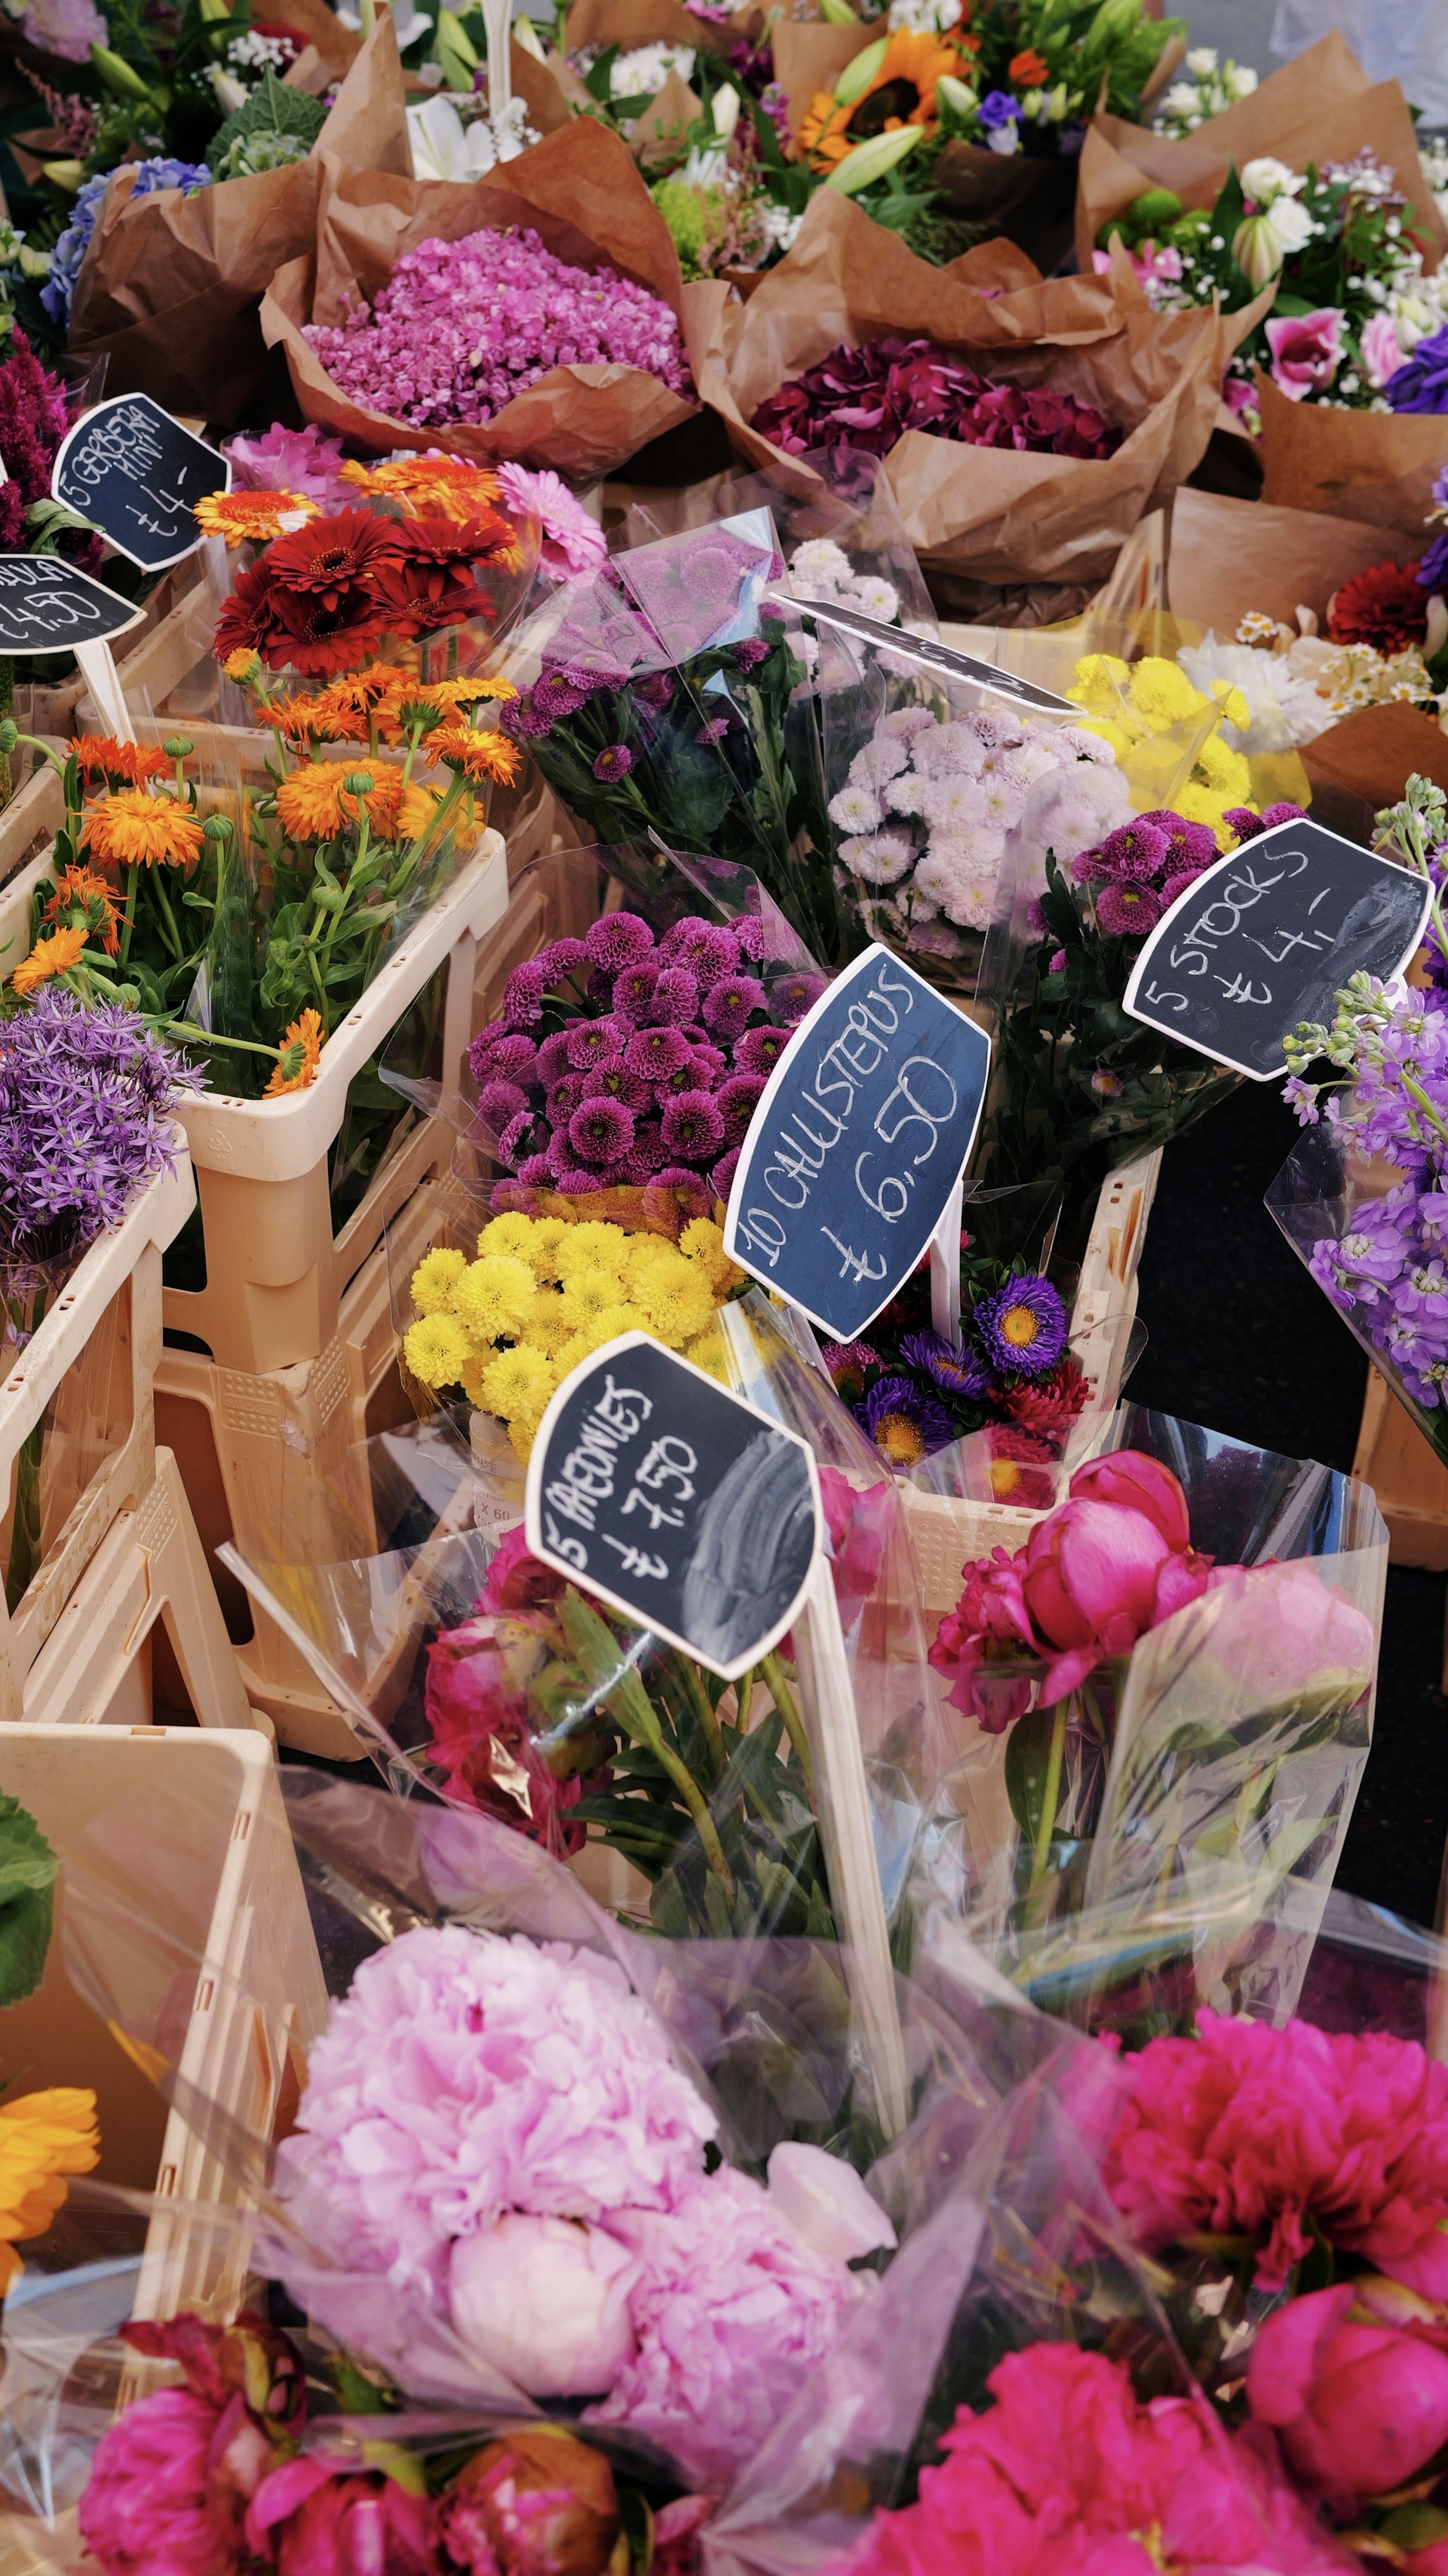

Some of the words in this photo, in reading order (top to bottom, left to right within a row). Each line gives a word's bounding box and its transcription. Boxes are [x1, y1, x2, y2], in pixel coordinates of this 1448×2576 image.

[113, 431, 164, 480] MINI
[59, 471, 91, 506] 5
[1145, 980, 1189, 1011] 5
[1170, 844, 1309, 976] STOCKS
[738, 1208, 787, 1268] 10
[763, 963, 914, 1210] CALLISTEPUS
[854, 1056, 959, 1224] 6,50
[228, 1397, 275, 1414] STICKER
[494, 1508, 511, 1521] 60
[544, 1511, 589, 1571] 5
